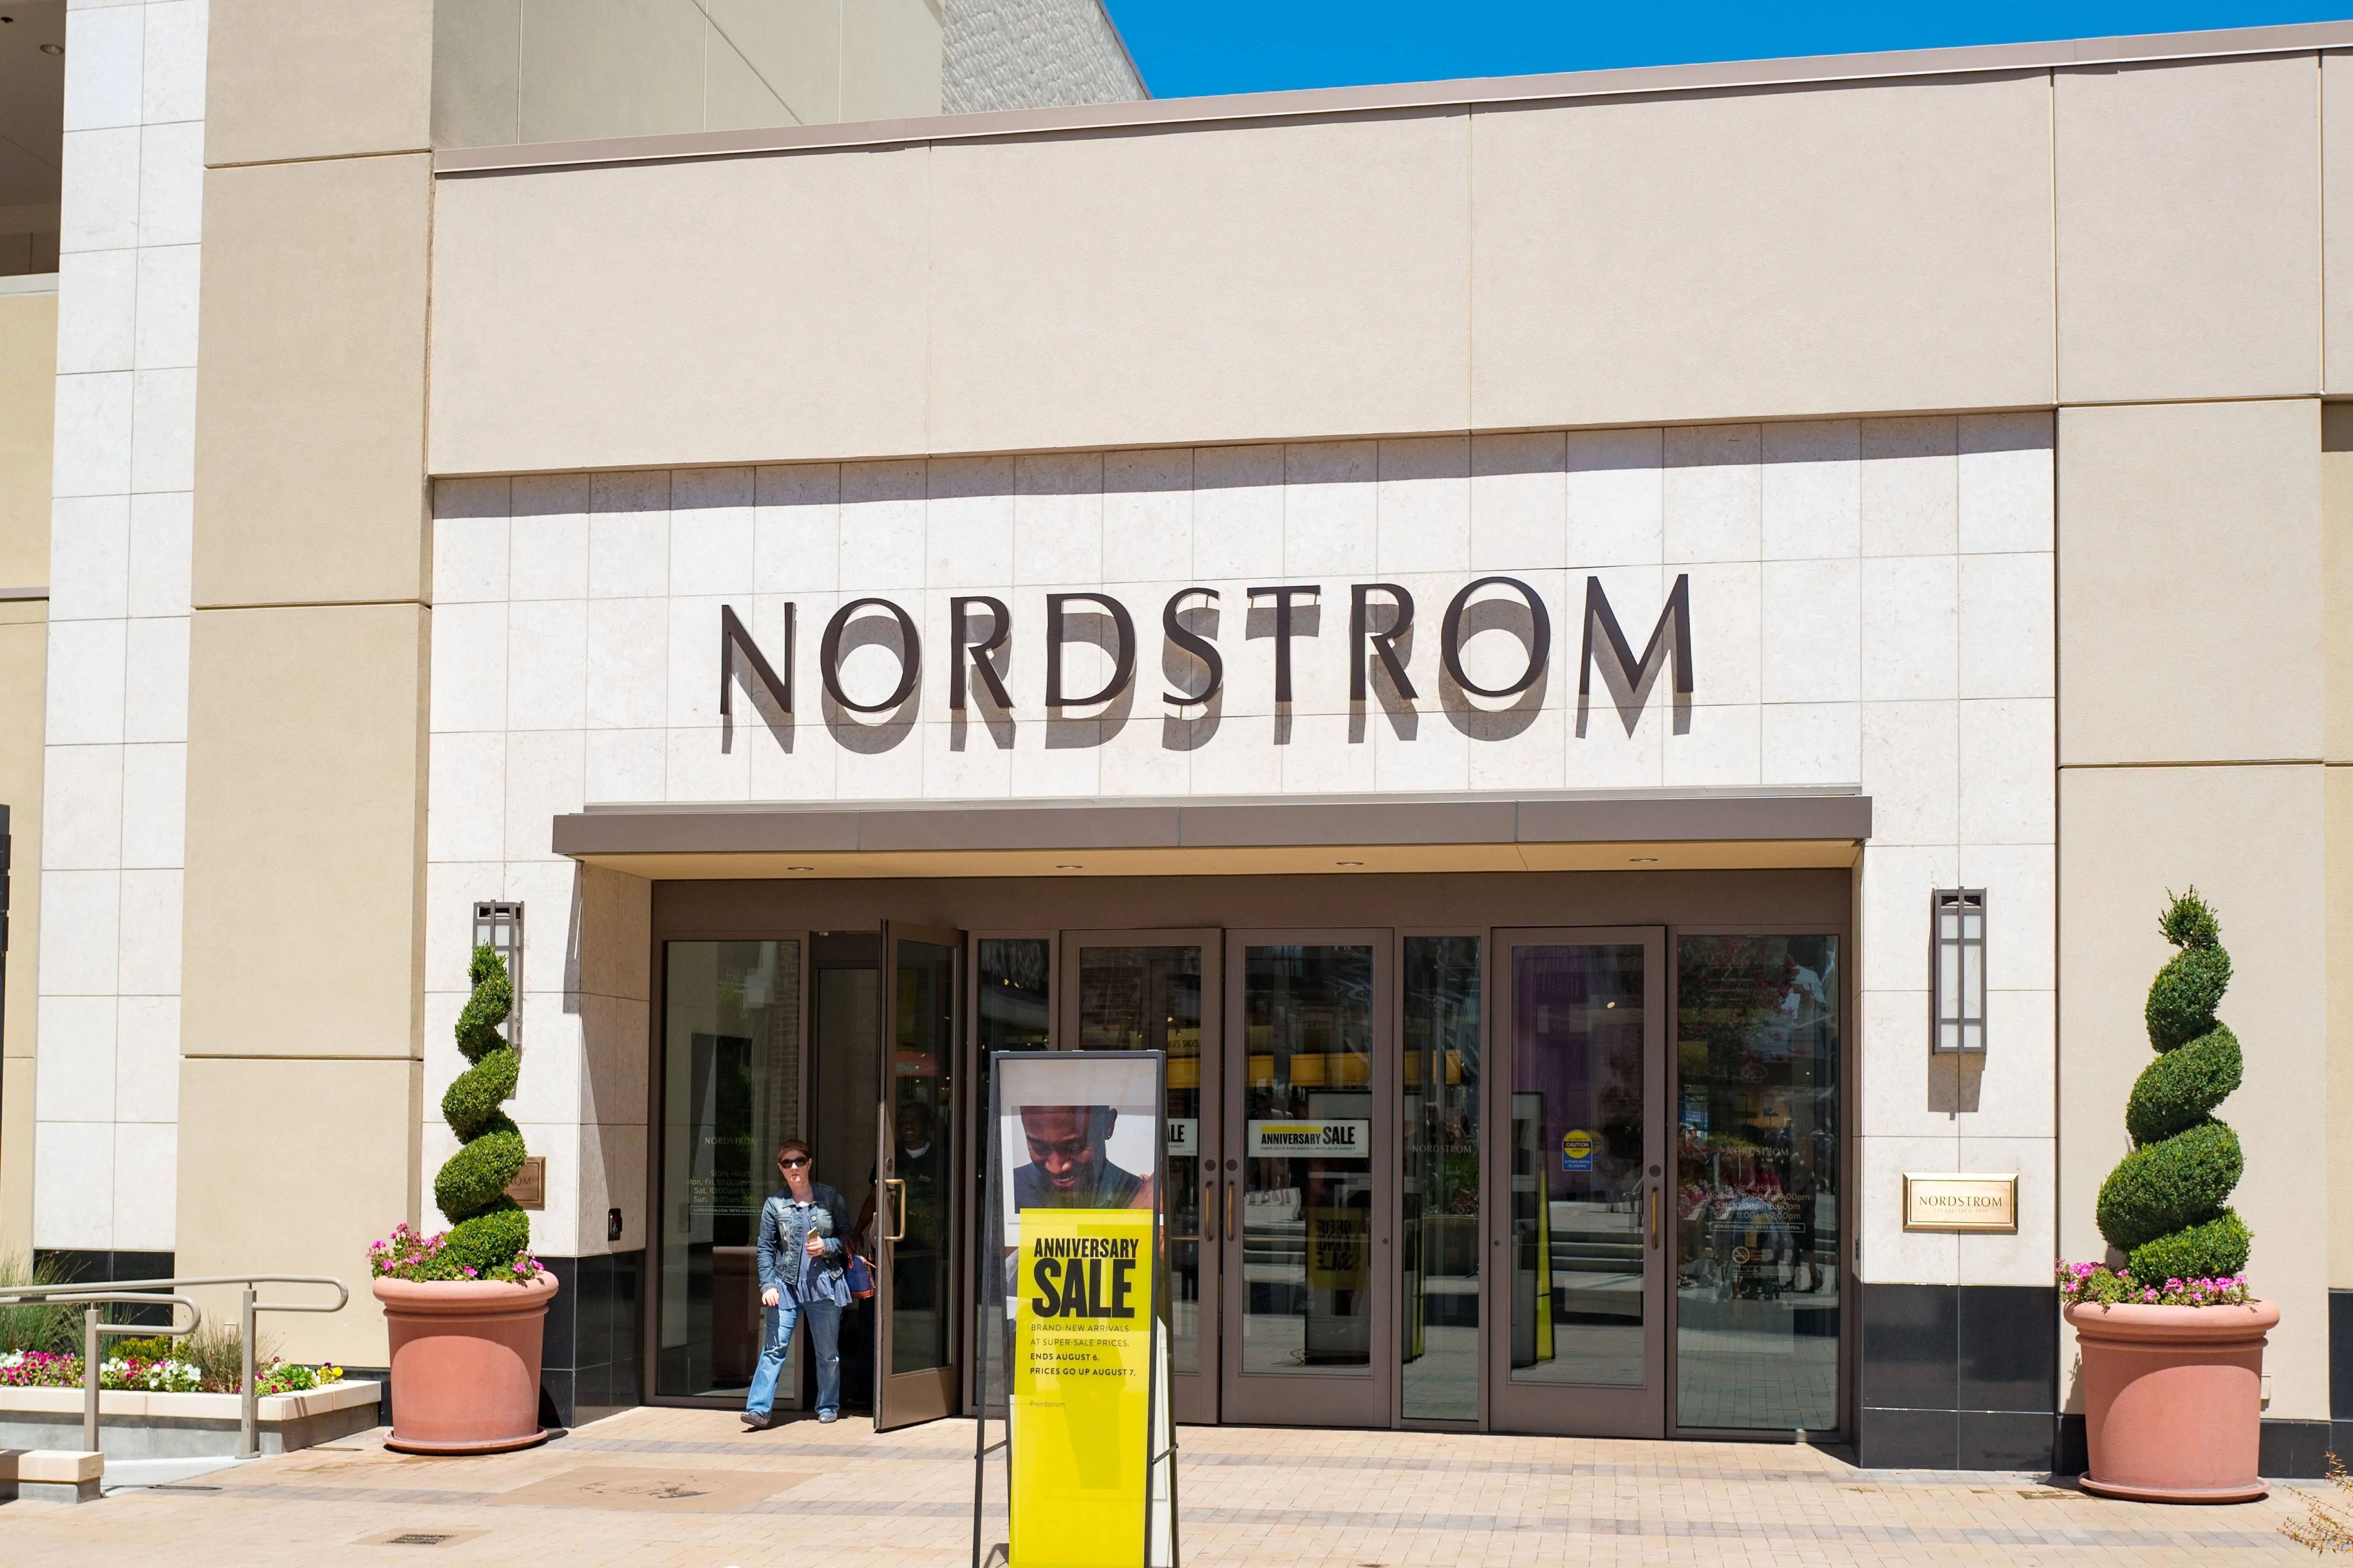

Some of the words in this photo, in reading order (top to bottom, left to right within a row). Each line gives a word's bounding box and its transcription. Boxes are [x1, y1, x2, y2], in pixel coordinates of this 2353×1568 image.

[720, 574, 1694, 715] NORDSTROM
[1261, 1133, 1321, 1144] ANNIVERSARY
[1323, 1126, 1355, 1144] SALE
[1919, 1196, 2002, 1207] NORDSTROM
[1034, 1238, 1139, 1258] ANNIVERSARY
[1032, 1257, 1136, 1319] SALE
